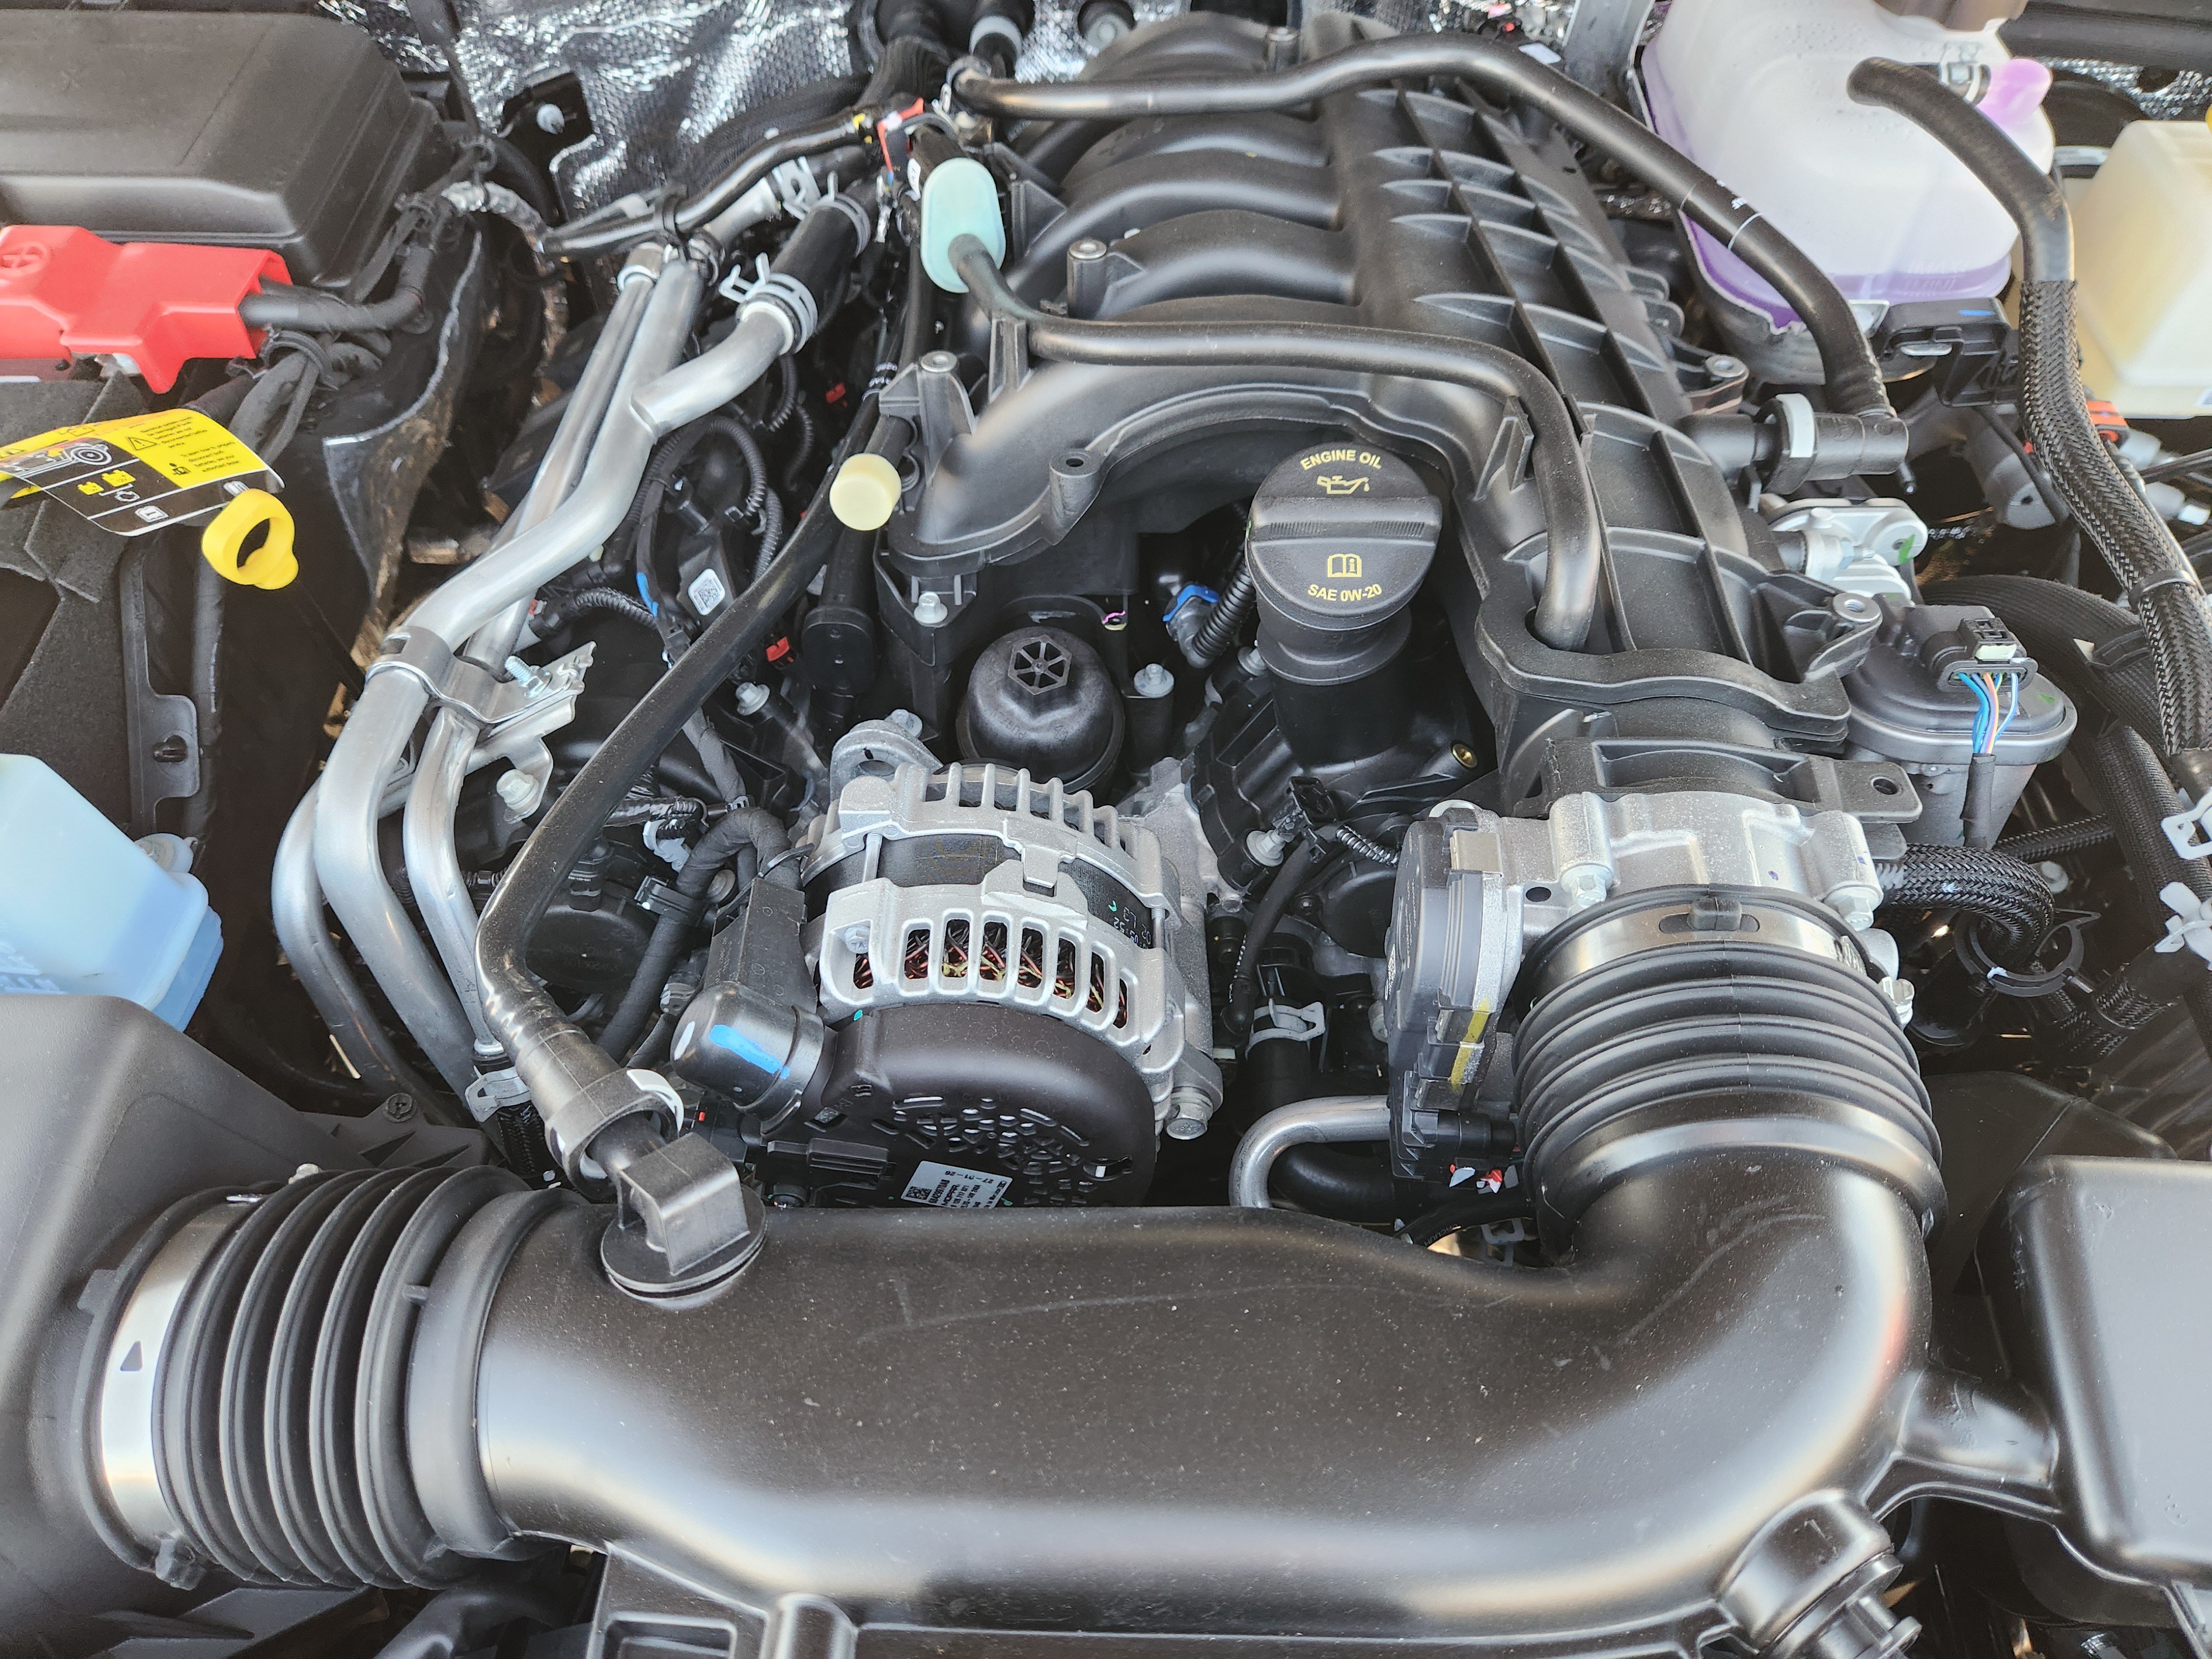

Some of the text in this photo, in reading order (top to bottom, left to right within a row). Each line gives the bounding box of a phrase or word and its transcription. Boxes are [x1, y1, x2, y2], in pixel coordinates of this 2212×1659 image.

[1300, 449, 1382, 470] ENGINE OIL
[1308, 583, 1382, 602] SAE 0W-20
[941, 1185, 959, 1206] MOPAR
